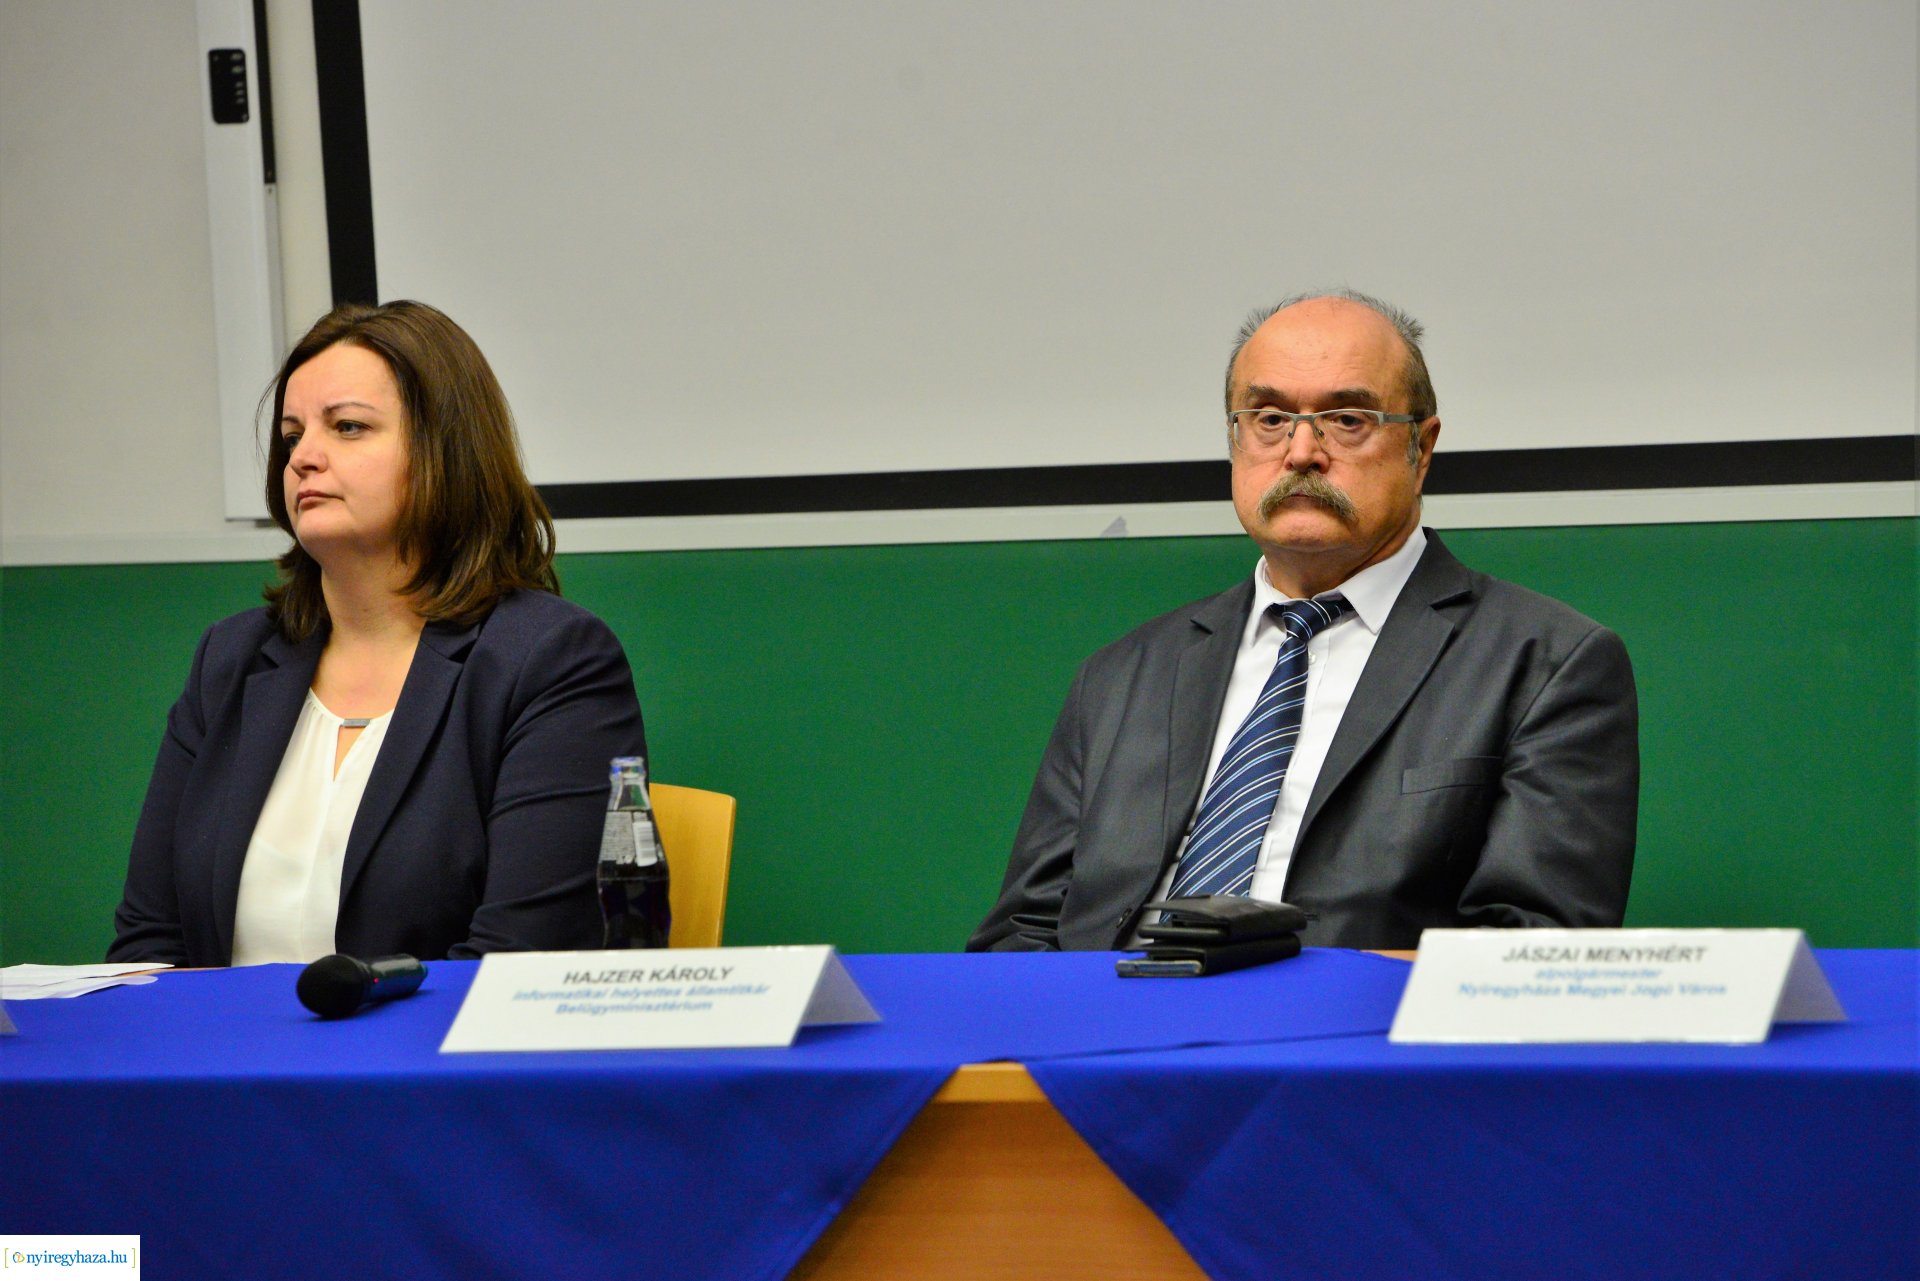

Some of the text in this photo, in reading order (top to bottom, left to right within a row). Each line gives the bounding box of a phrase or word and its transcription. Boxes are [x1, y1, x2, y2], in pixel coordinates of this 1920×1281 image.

[1502, 944, 1707, 962] JÁSZAI MENYHÉRT
[563, 965, 735, 984] HAJZER KÁROLY
[611, 983, 681, 999] helyettes
[1566, 982, 1627, 998] Megyei
